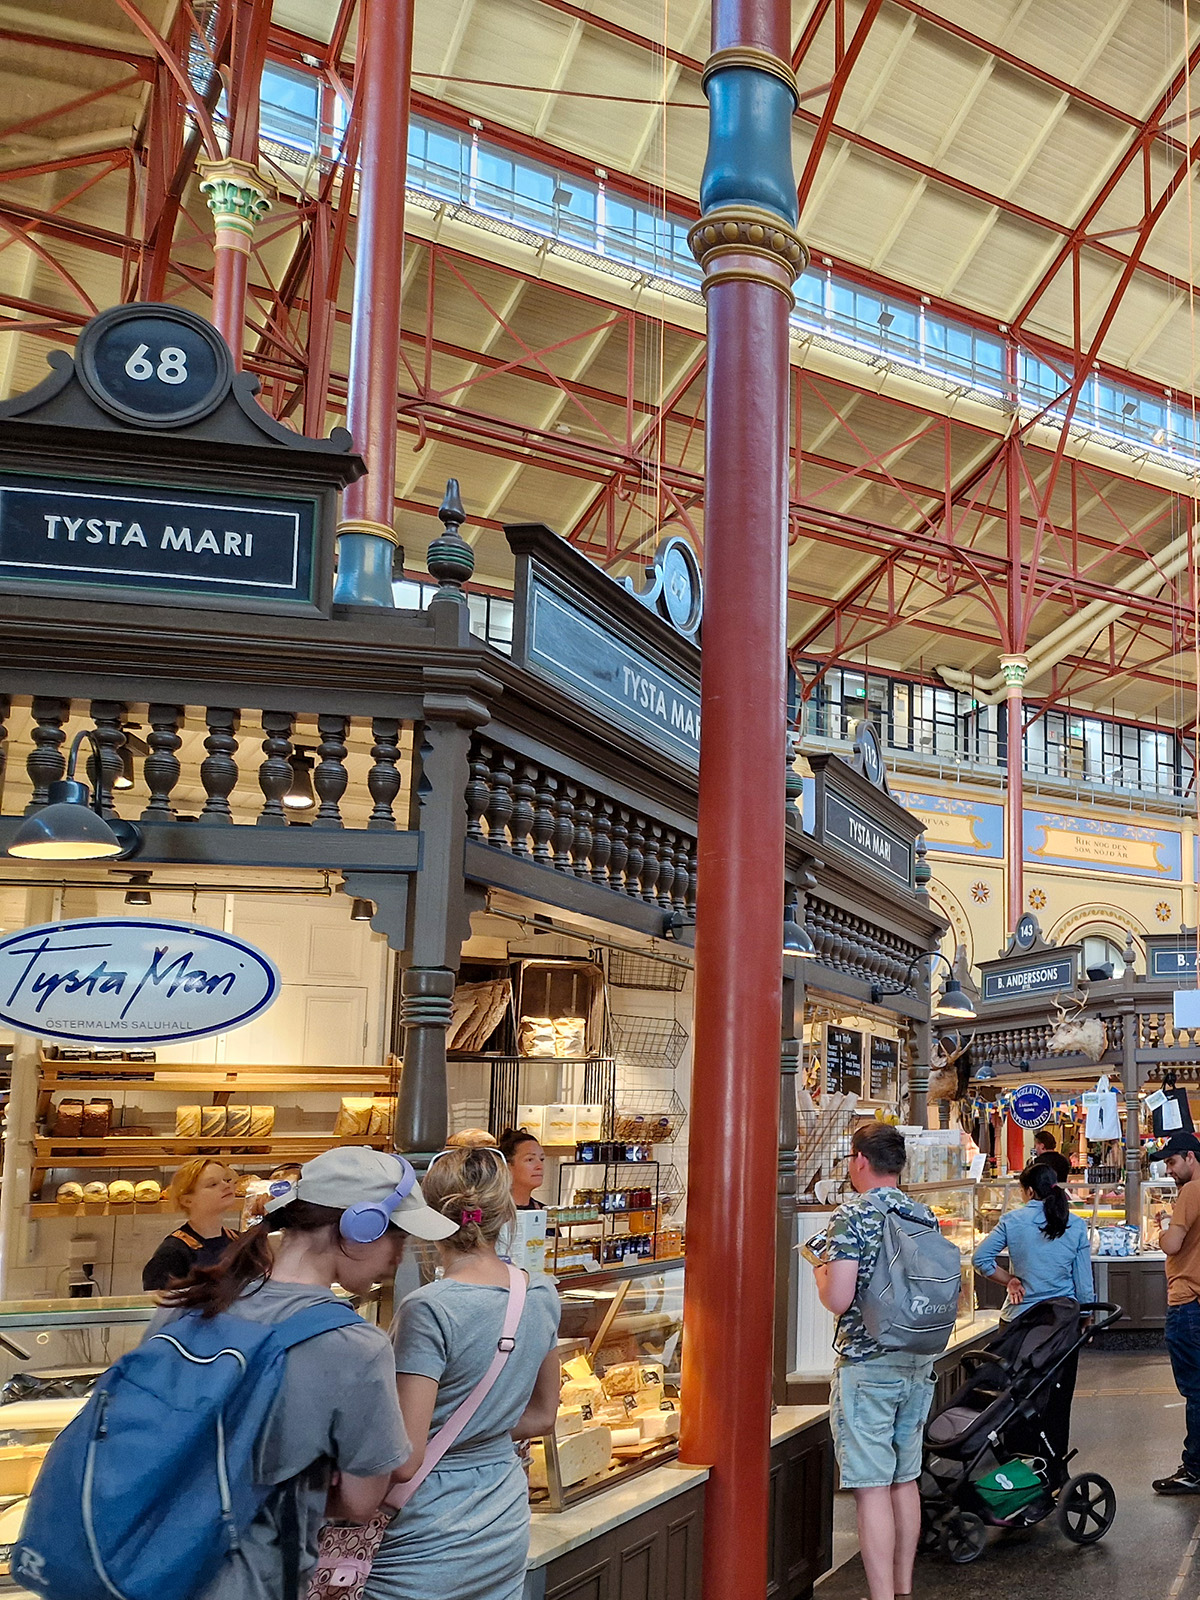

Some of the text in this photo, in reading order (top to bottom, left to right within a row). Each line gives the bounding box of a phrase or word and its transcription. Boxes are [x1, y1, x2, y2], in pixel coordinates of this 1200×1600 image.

[124, 343, 188, 385] 68
[44, 514, 254, 557] TYSTA MARI
[622, 665, 668, 722] TYSTA
[863, 742, 878, 770] 112
[848, 817, 891, 862] TYSTA MARI
[1020, 924, 1033, 938] 143
[1177, 954, 1190, 967] B.
[8, 937, 246, 1020] Tysta Mari
[997, 968, 1058, 989] B. ANDERSSONS
[45, 1017, 193, 1030] ÖSTERMALMS SALUHALL
